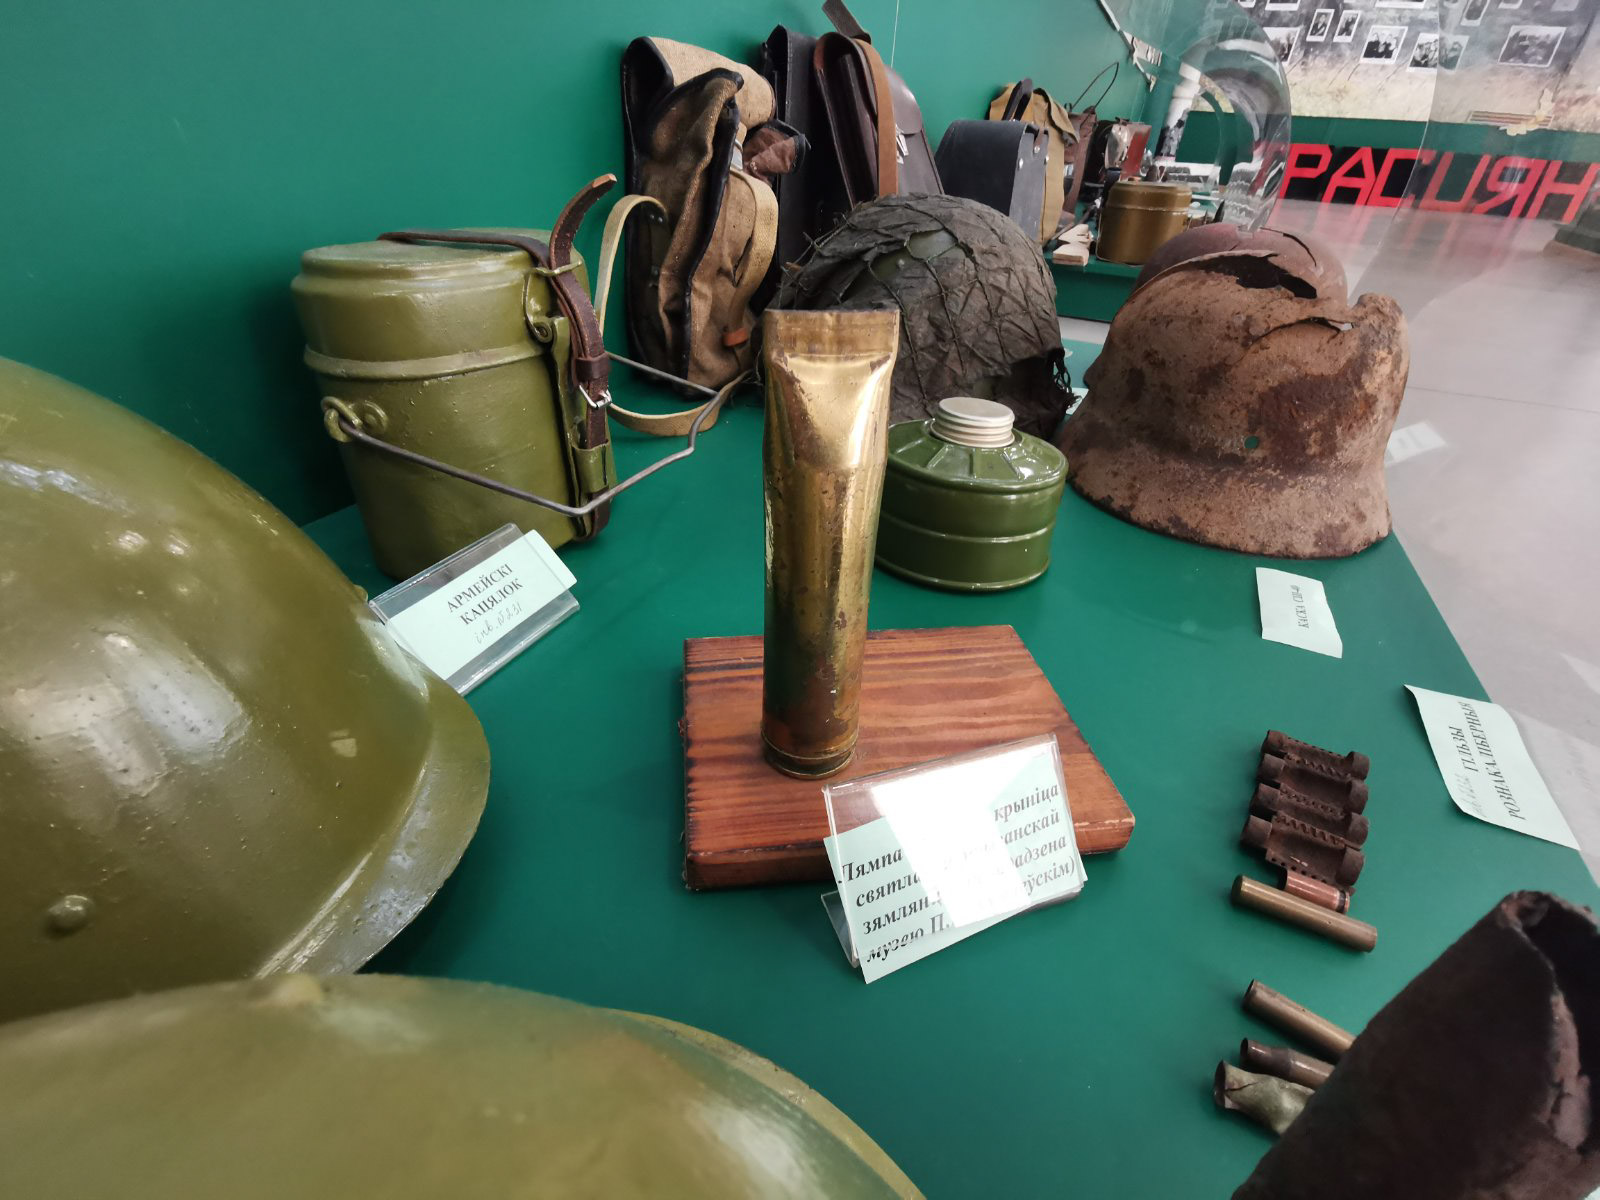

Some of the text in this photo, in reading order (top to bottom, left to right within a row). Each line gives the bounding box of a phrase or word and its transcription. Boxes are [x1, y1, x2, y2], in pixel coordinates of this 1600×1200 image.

[447, 563, 513, 613] АРМЕЙСКІ
[460, 578, 523, 625] КАЦЯЛОК
[1296, 605, 1310, 629] КАСКА
[1448, 725, 1479, 773] ГІЛЬЗЫ
[1457, 700, 1527, 821] РОЗНАКАЛІБЕРНЫЯ
[837, 848, 903, 884] Лямпа
[993, 783, 1060, 823] крыніца
